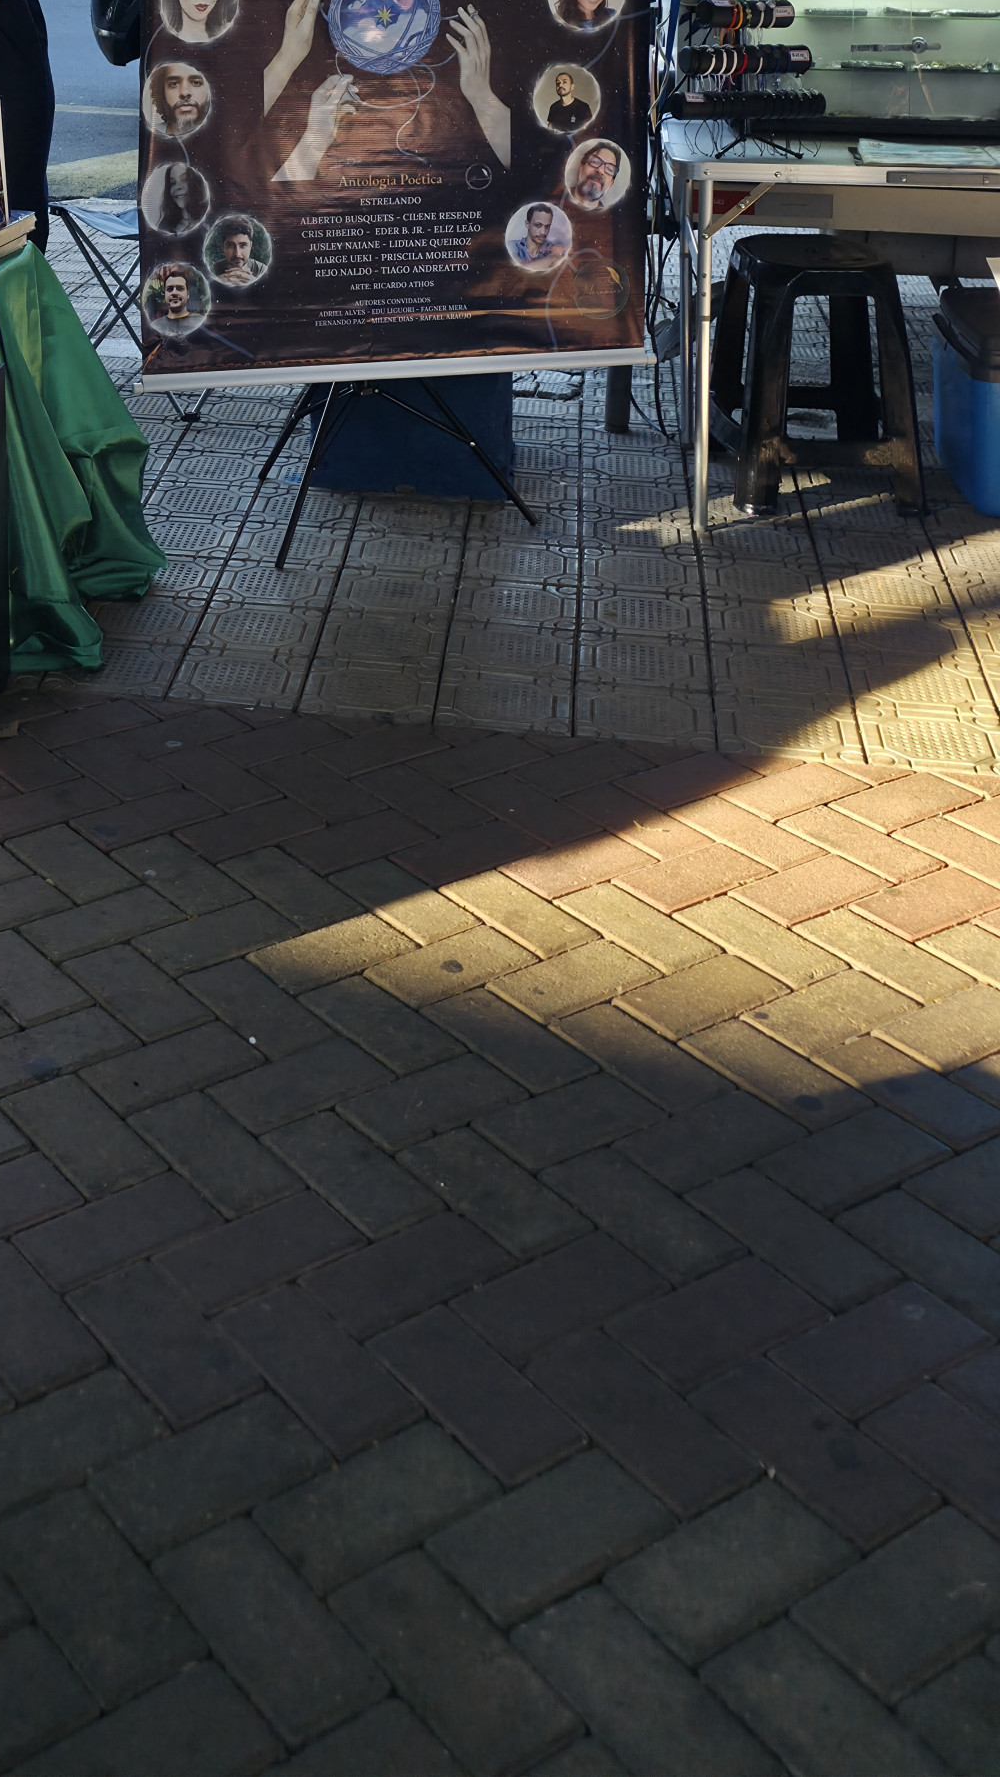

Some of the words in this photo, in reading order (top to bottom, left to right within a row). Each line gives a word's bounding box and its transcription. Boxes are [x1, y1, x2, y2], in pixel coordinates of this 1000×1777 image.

[338, 175, 397, 190] Antologia
[400, 172, 443, 185] Poética
[360, 196, 422, 206] ESTRELANDO
[300, 215, 343, 225] ALBERTO
[345, 214, 394, 225] BUSQUETS
[402, 212, 437, 222] CILENE
[439, 211, 482, 220] RESENDE
[301, 229, 324, 239] CRIS
[326, 228, 363, 238] RIBEIRO
[375, 226, 399, 236] EDER
[401, 226, 410, 235] B.
[411, 226, 425, 234] JR.
[456, 223, 481, 233] LEÃO
[309, 242, 343, 252] JUSLEY
[345, 241, 380, 250] NAIANE
[389, 238, 428, 248] LIDIANE
[429, 237, 472, 248] QUEIROZ
[314, 255, 348, 264] MARGE
[350, 254, 372, 263] UEKI
[381, 252, 423, 262] PRISCILA
[425, 251, 469, 260] MOREIRA
[340, 267, 372, 277] NALDO
[381, 265, 410, 275] TIAGO
[412, 263, 469, 273] ANDREATTO
[350, 283, 372, 291] ARTE:
[373, 281, 407, 290] RICARDO
[408, 280, 435, 289] ATHOS
[354, 299, 385, 307] AUTORES
[386, 296, 431, 305] CONVIDADOS
[318, 310, 343, 318] ADRIEL
[344, 308, 366, 316] ALVES
[371, 307, 386, 315] EDU
[386, 306, 415, 315] LIGUORI
[420, 304, 447, 313] FAGNER
[448, 304, 468, 312] MERA
[315, 318, 352, 327] FERNANDO
[371, 316, 397, 324] MILENE
[398, 315, 414, 323] DIAS
[419, 314, 445, 322] RAFAEL
[445, 312, 472, 321] ARAÚJO
